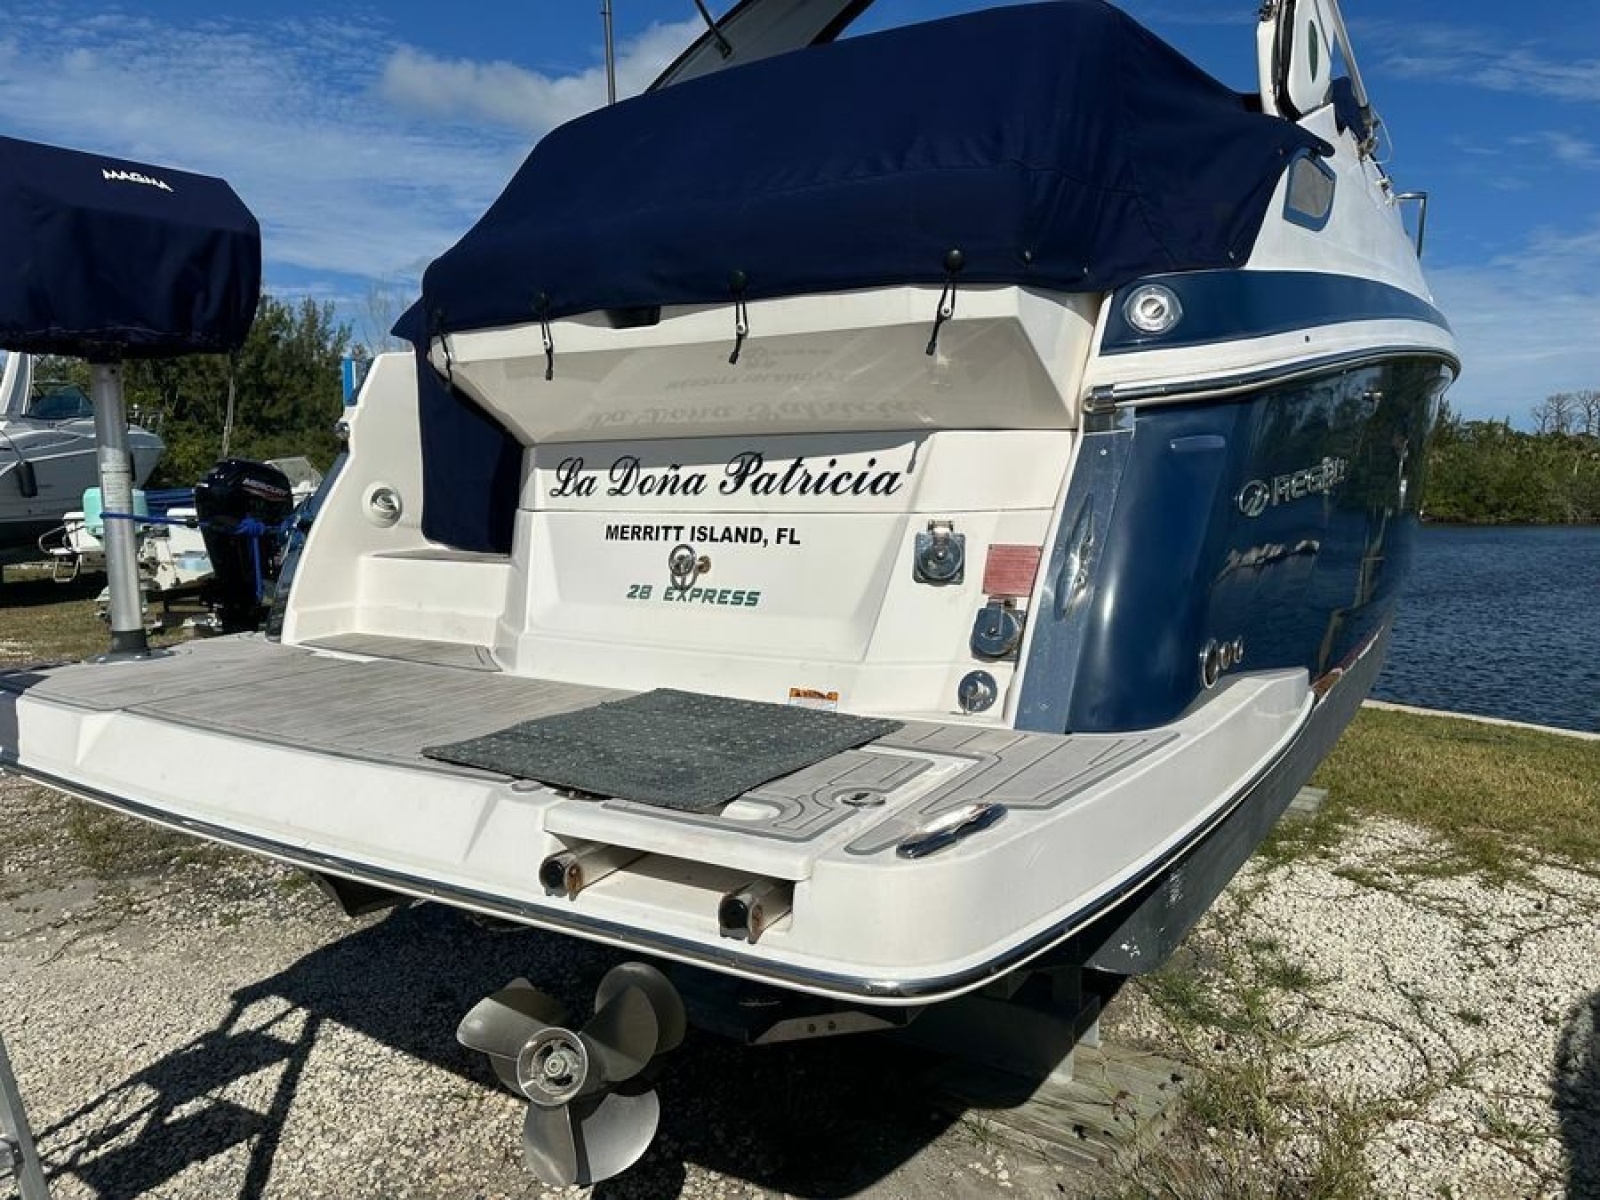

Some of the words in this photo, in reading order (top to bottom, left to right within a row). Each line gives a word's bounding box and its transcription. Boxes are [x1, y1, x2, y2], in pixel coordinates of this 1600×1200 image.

[101, 168, 174, 193] MAGMA
[550, 456, 598, 497] La
[607, 454, 708, 497] Doña
[719, 451, 903, 497] Patricia
[605, 524, 685, 541] MERRITT
[689, 525, 769, 549] ISLAND,
[775, 527, 801, 545] FL
[626, 584, 653, 600] 28
[662, 586, 761, 607] EXPRESS
